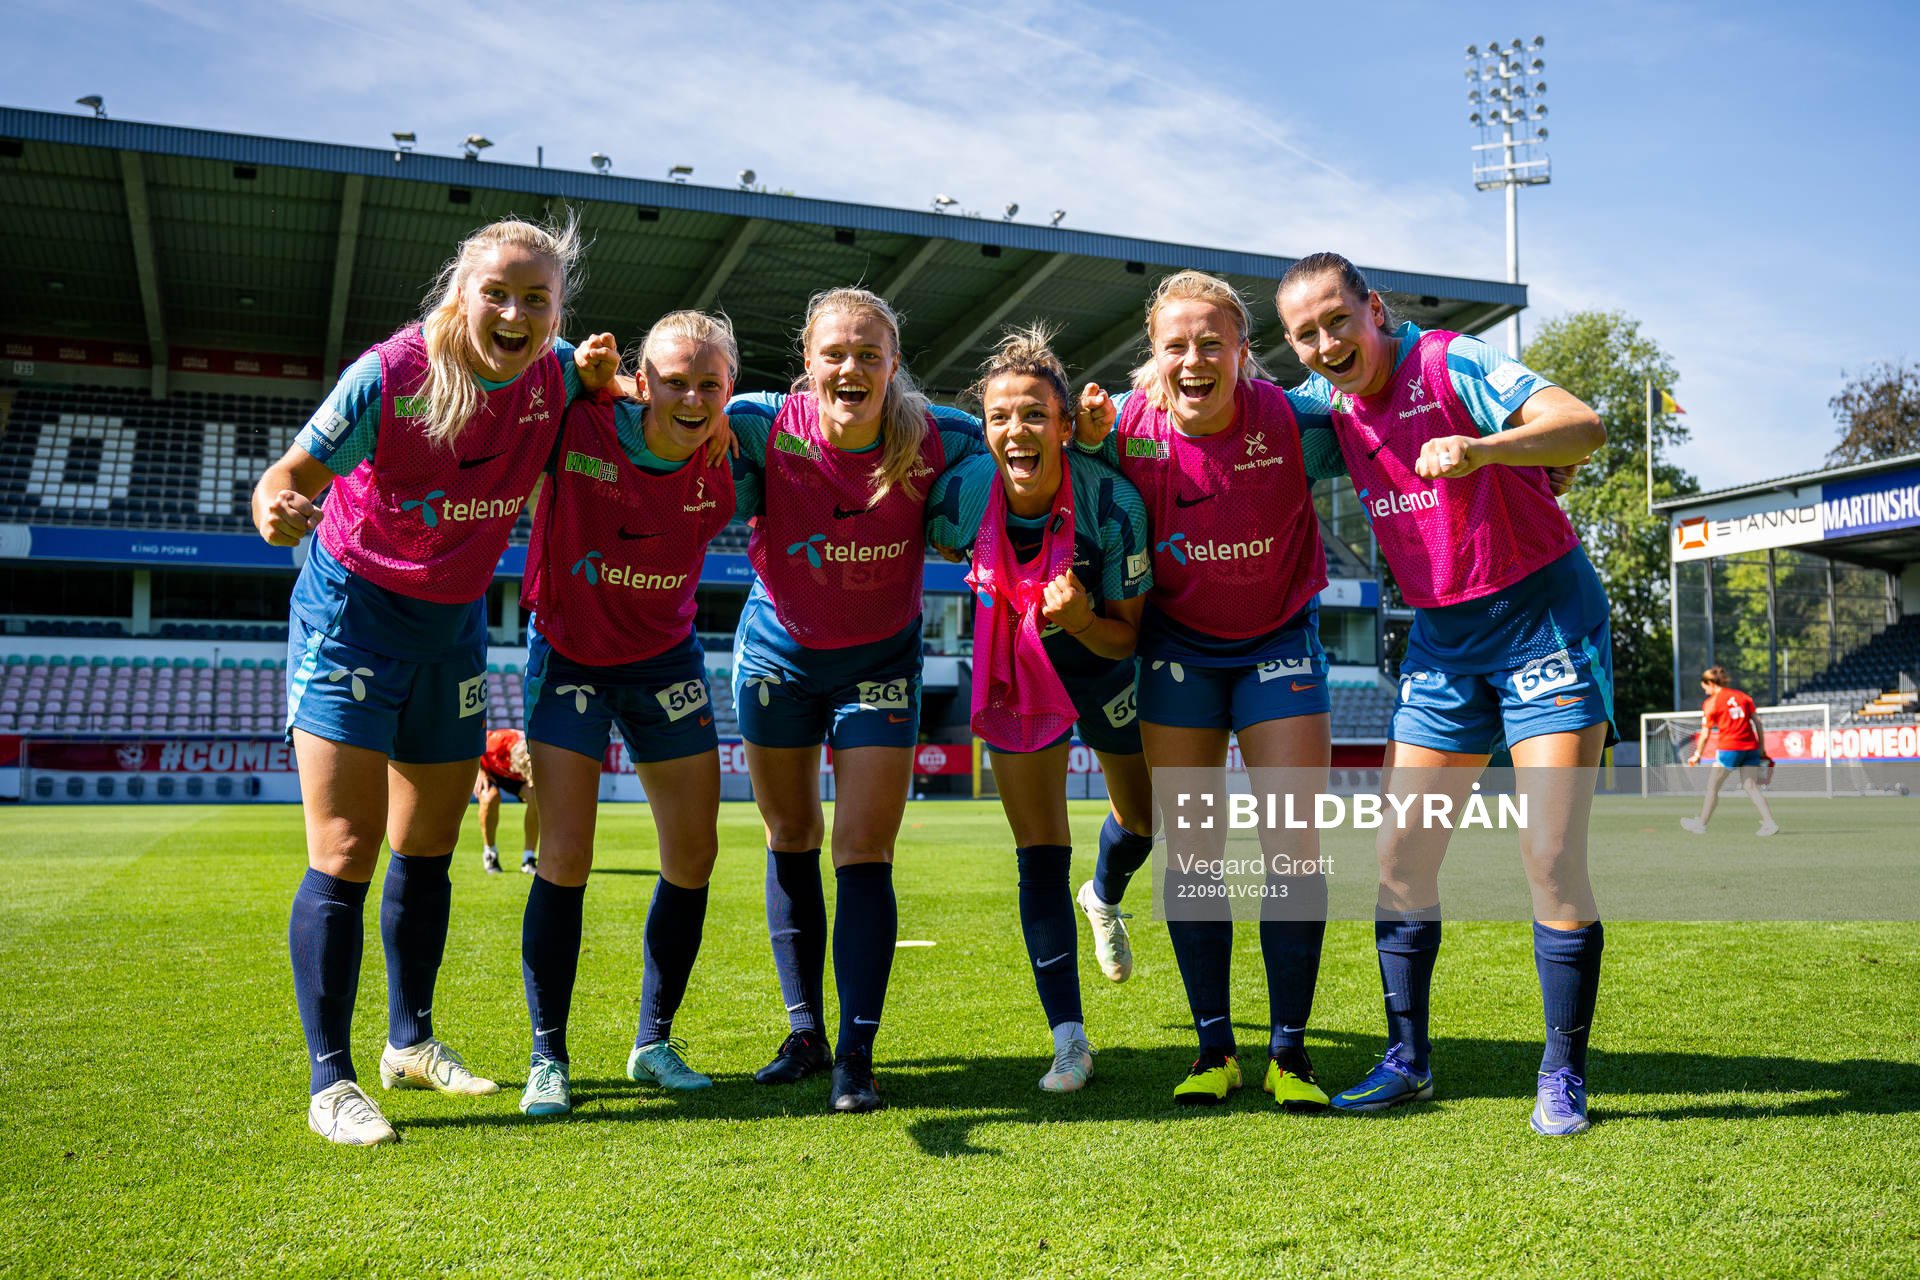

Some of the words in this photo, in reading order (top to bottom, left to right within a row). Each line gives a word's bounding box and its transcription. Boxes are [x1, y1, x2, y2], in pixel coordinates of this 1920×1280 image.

[774, 431, 811, 457] KIWI
[1126, 437, 1157, 458] KIWI
[565, 451, 602, 478] KIWI
[1234, 461, 1256, 471] Norsk
[1256, 457, 1284, 467] Tipping
[442, 496, 524, 521] telenor
[824, 539, 910, 562] telenor
[1185, 537, 1274, 562] telenor
[600, 562, 687, 589] telenor
[1519, 658, 1569, 693] 5G
[668, 682, 702, 711] 5G
[865, 684, 903, 703] 5G
